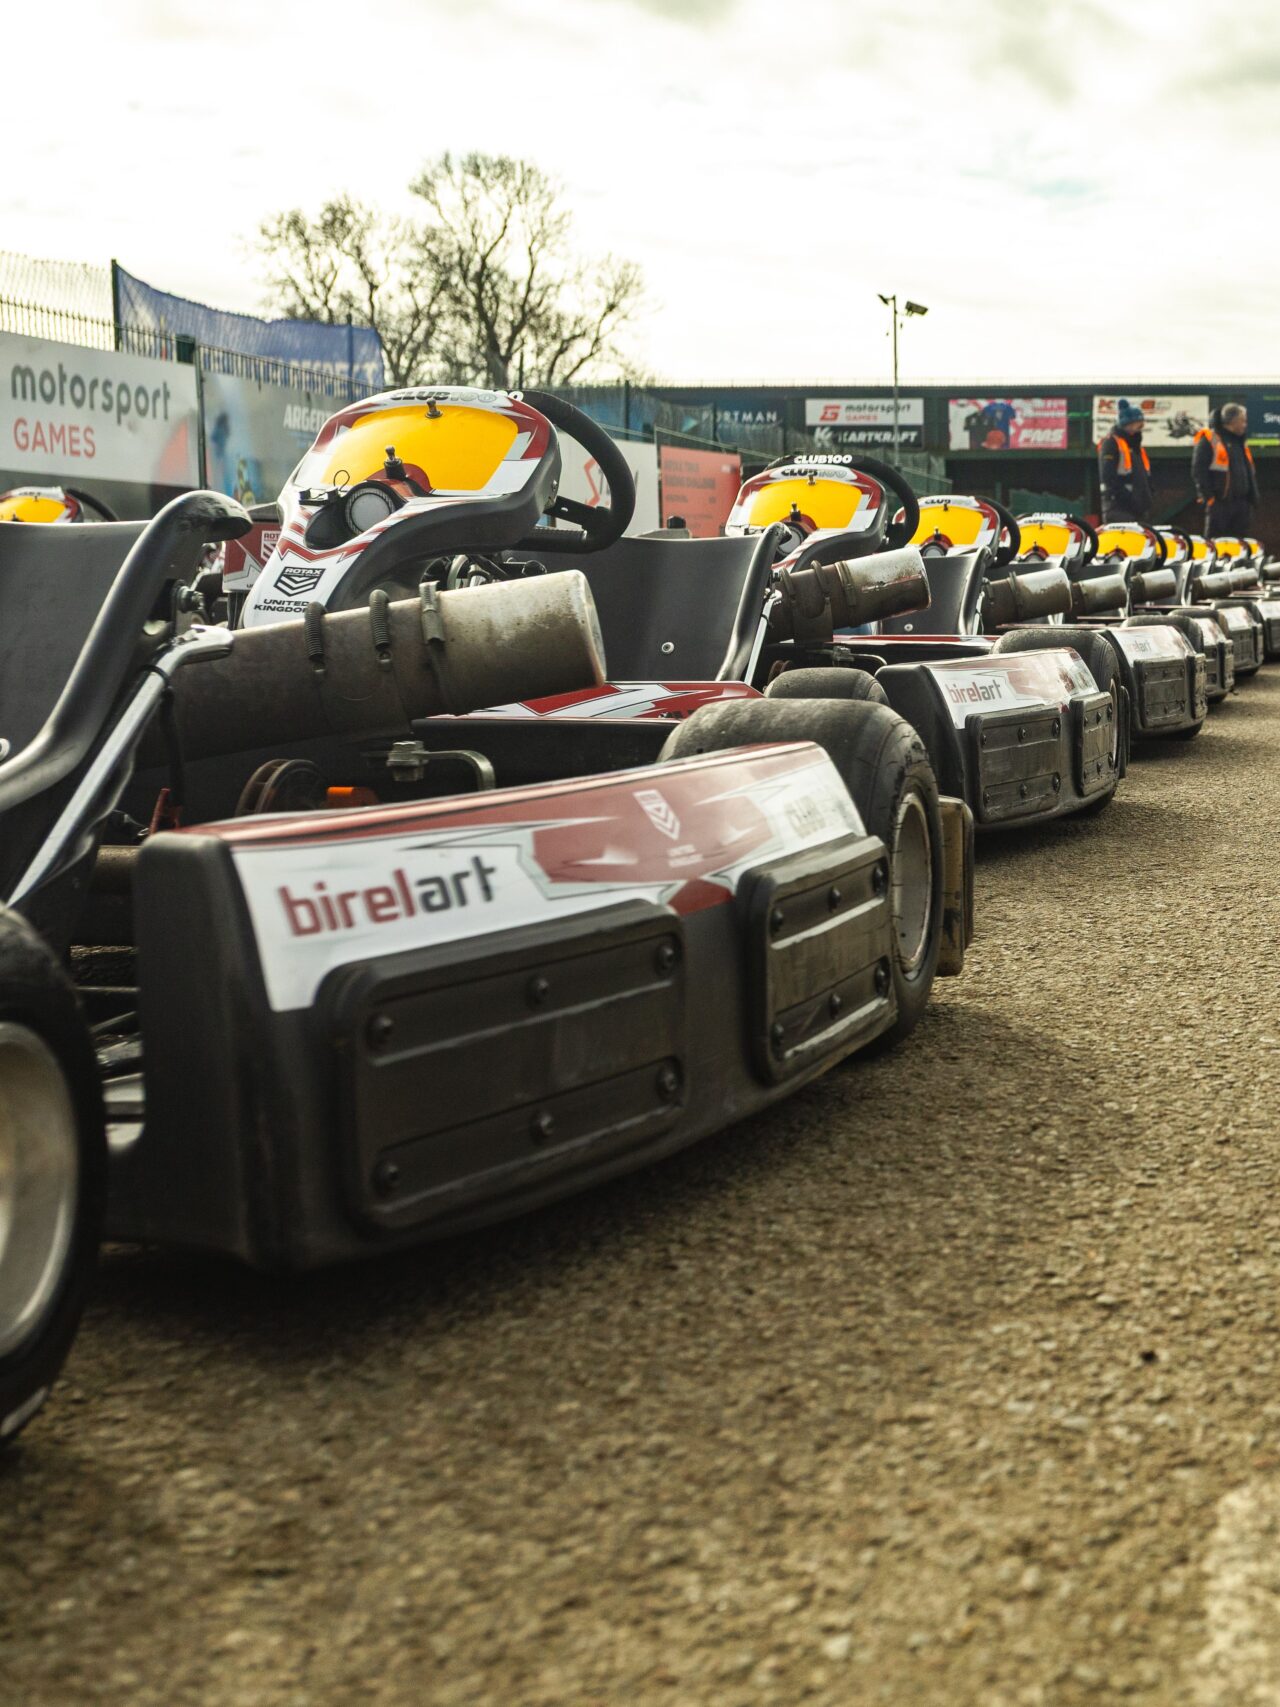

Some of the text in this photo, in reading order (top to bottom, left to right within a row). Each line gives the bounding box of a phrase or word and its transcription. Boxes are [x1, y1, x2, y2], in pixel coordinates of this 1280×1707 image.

[11, 363, 170, 426] motorsport
[13, 417, 96, 459] GAMES
[793, 454, 853, 465] CLUB100
[263, 532, 280, 540] ROT
[263, 598, 309, 606] UNITED
[253, 604, 306, 614] KINGDO
[278, 856, 496, 936] birelart
